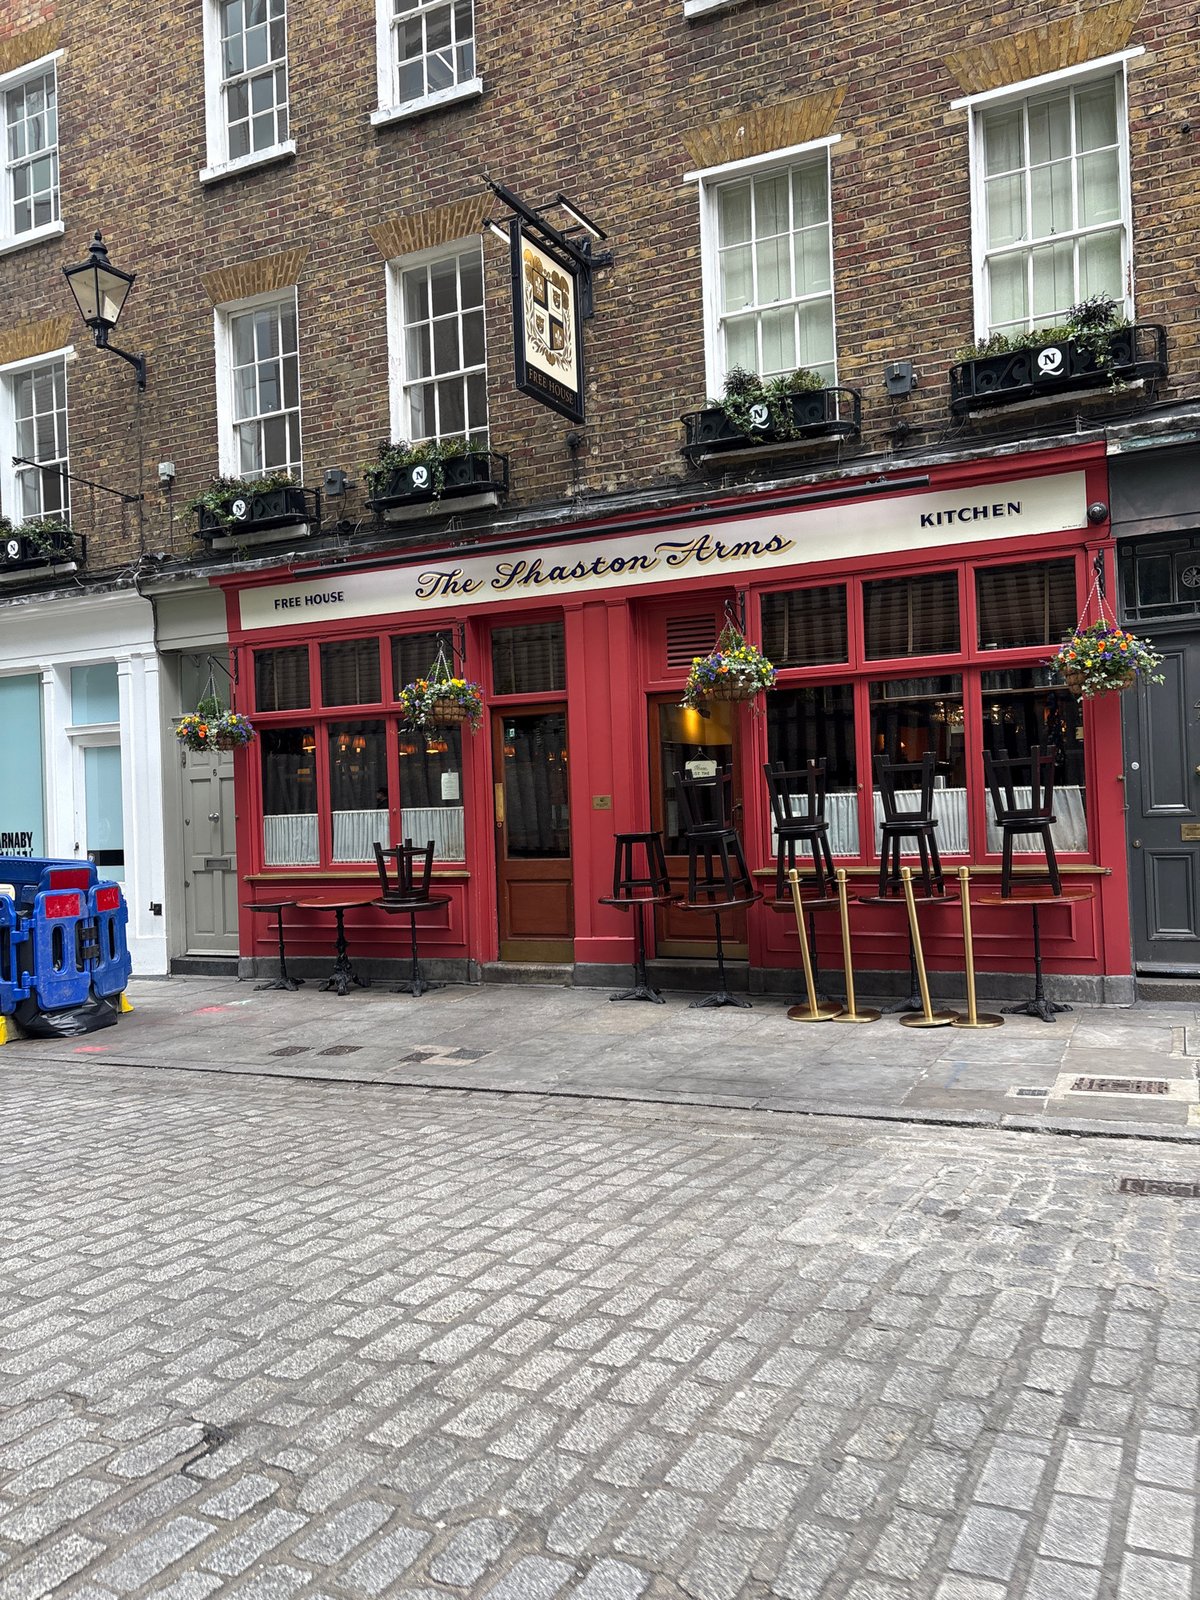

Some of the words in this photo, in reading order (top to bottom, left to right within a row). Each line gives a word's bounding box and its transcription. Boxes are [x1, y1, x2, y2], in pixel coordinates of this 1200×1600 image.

[528, 368, 547, 389] FREE
[548, 380, 574, 405] HOUSE
[920, 501, 1022, 528] KITCHEN
[415, 568, 485, 601] The
[491, 555, 660, 592] Shaston
[654, 533, 796, 569] Arms
[274, 596, 301, 610] FREE
[304, 591, 344, 606] HOUSE
[0, 832, 33, 848] RNABY
